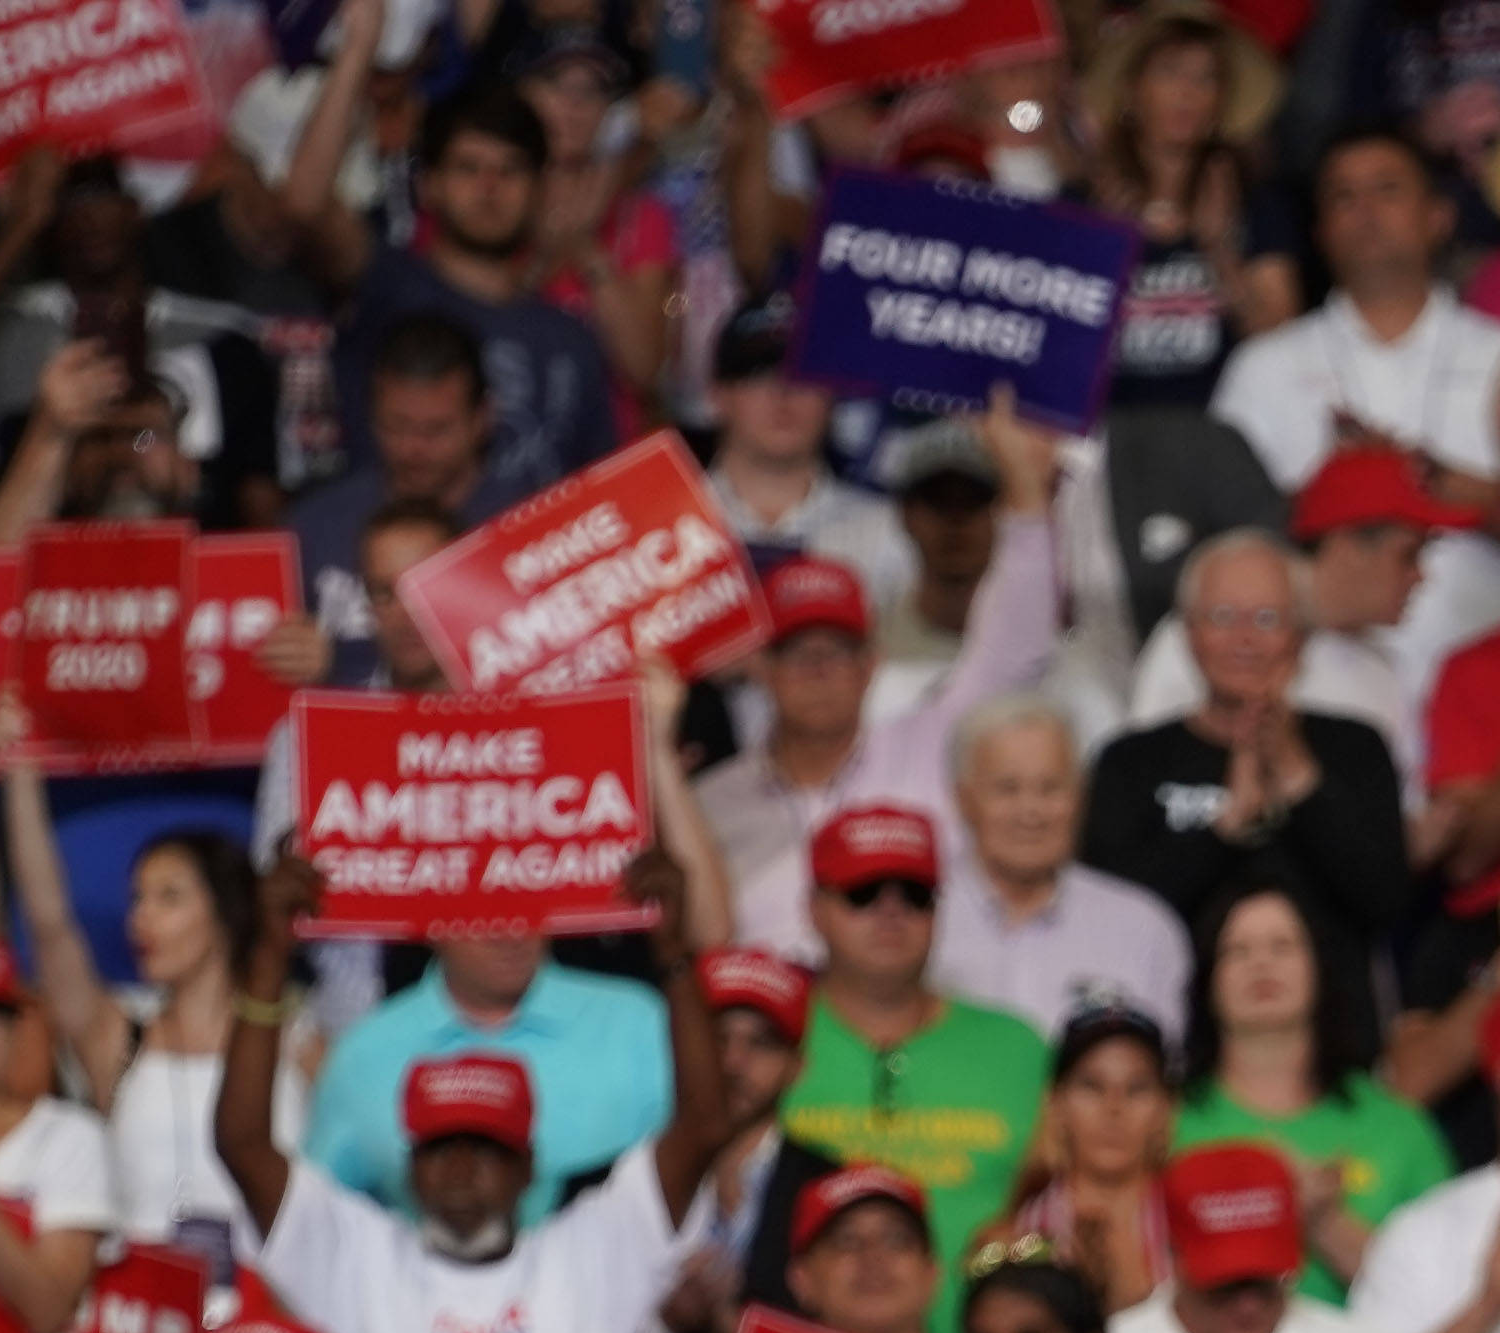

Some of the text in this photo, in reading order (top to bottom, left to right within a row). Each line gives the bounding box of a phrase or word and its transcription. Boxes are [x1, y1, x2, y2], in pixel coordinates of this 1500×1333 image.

[820, 222, 962, 288] FOUR
[960, 244, 1116, 330] MORE
[863, 284, 1046, 368] YEARS!
[465, 511, 736, 690] AMERICA
[396, 726, 546, 782] MAKE
[310, 771, 635, 844] AMERICA
[312, 839, 637, 896] GREAT AGAIN
